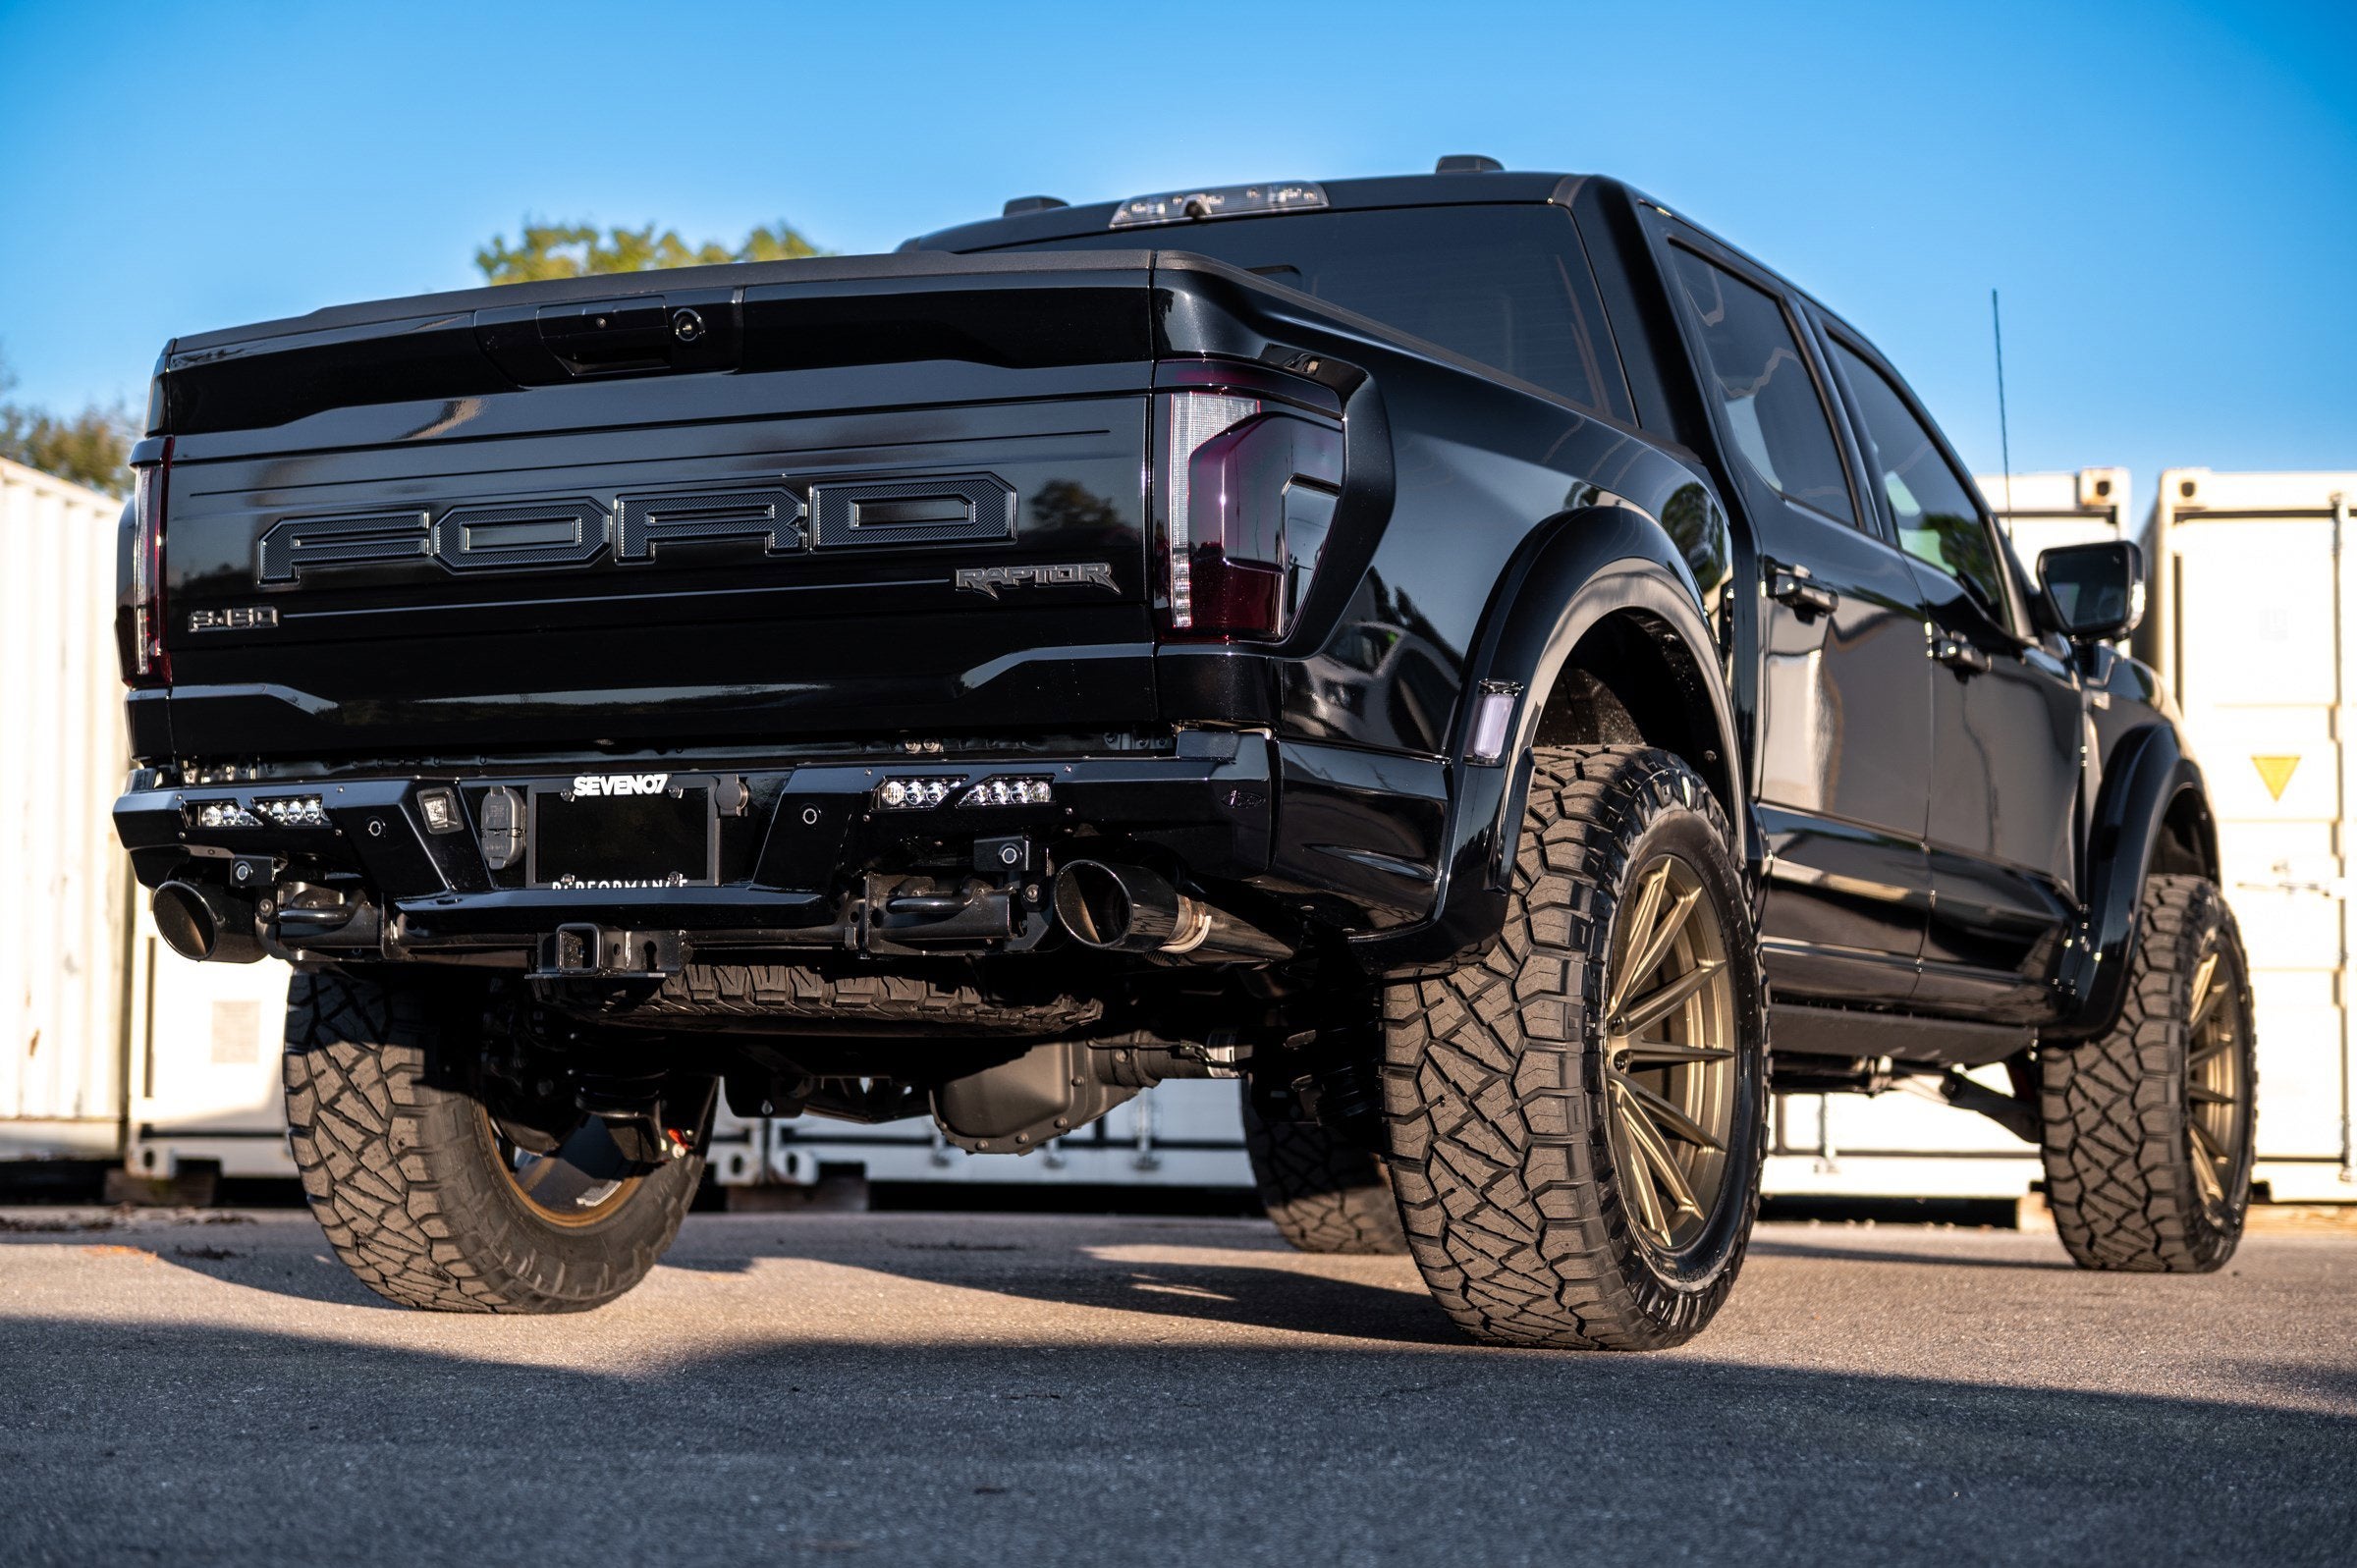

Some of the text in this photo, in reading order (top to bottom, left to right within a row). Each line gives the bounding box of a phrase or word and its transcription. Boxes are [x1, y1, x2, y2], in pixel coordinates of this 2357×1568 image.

[257, 472, 1018, 587] FORD
[956, 563, 1123, 600] RAPTOR
[189, 606, 279, 632] F-150
